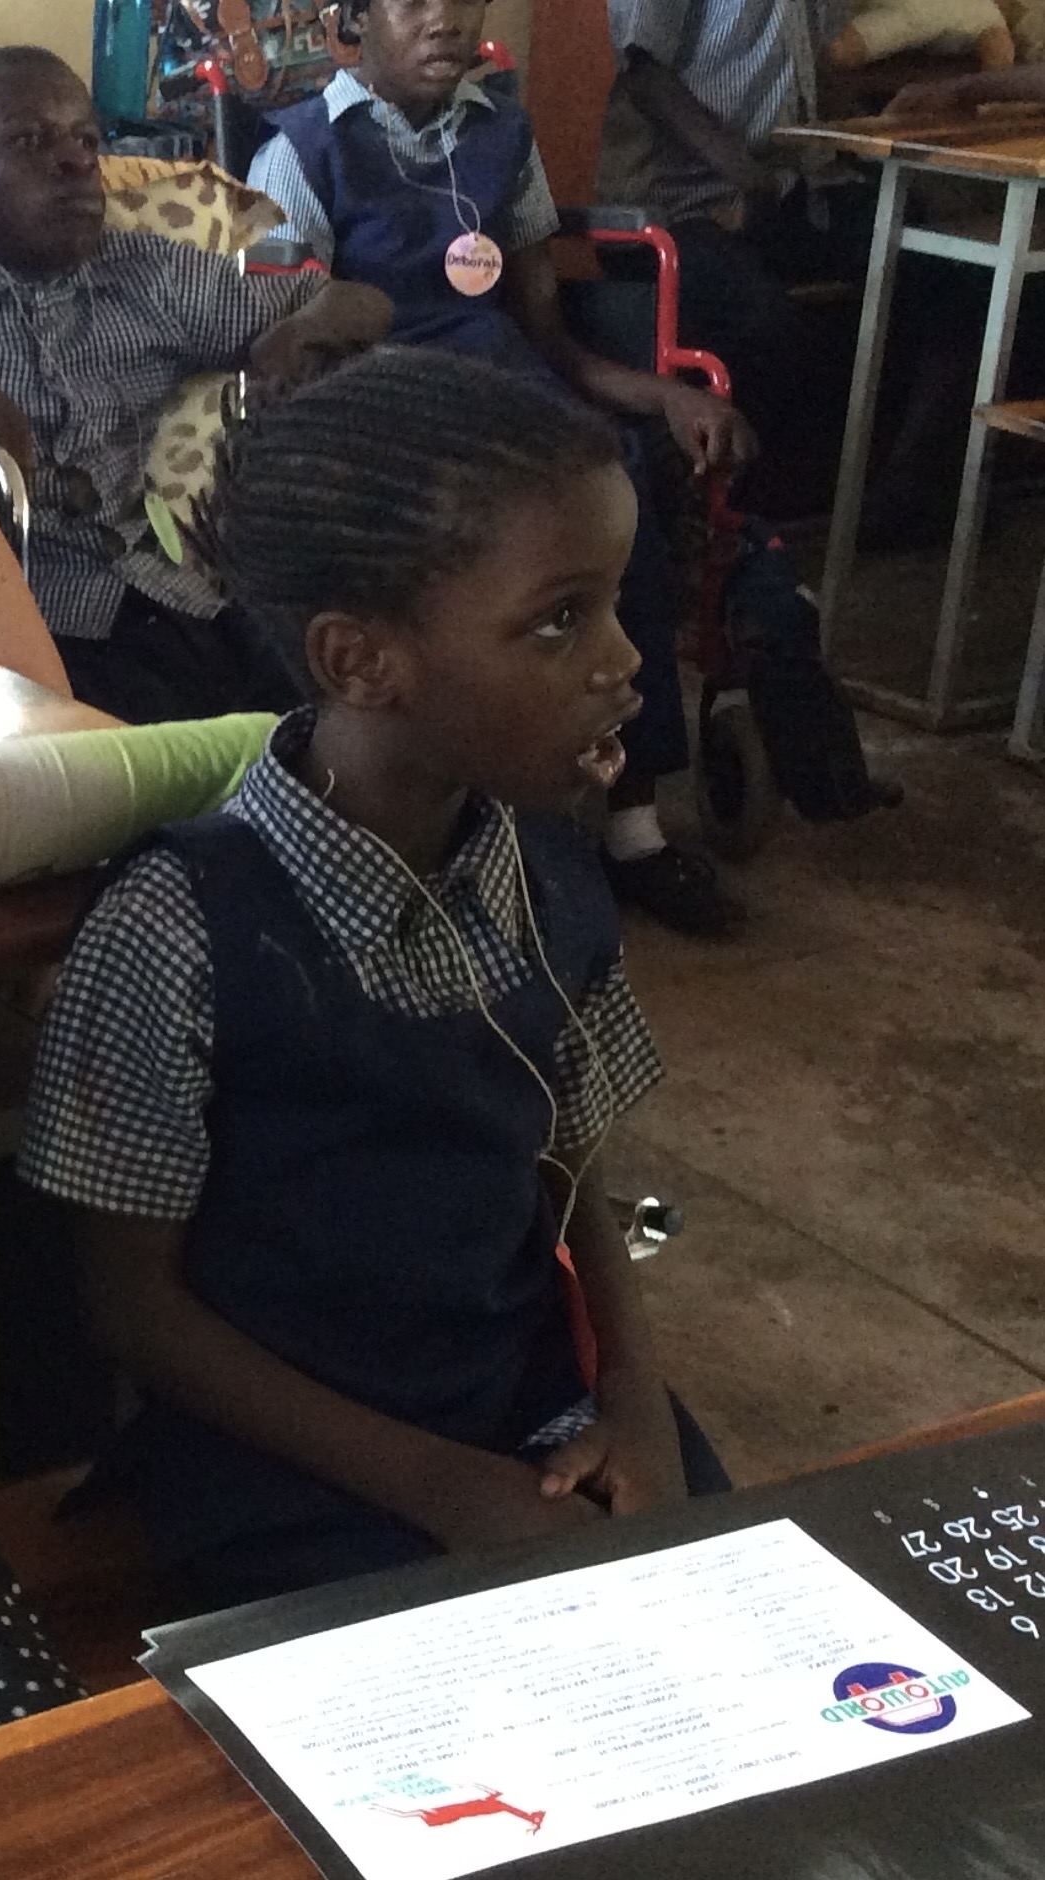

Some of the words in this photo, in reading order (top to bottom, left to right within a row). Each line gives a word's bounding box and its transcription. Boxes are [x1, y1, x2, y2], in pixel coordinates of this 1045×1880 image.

[447, 252, 501, 269] Deborah
[943, 1517, 991, 1543] 26
[991, 1505, 1039, 1531] 25
[901, 1530, 942, 1557] 27
[928, 1556, 978, 1584] 20
[984, 1545, 1028, 1570] 19
[966, 1585, 1015, 1613] 13
[1010, 1615, 1039, 1639] 6
[820, 1669, 970, 1723] AUTOWORLD
